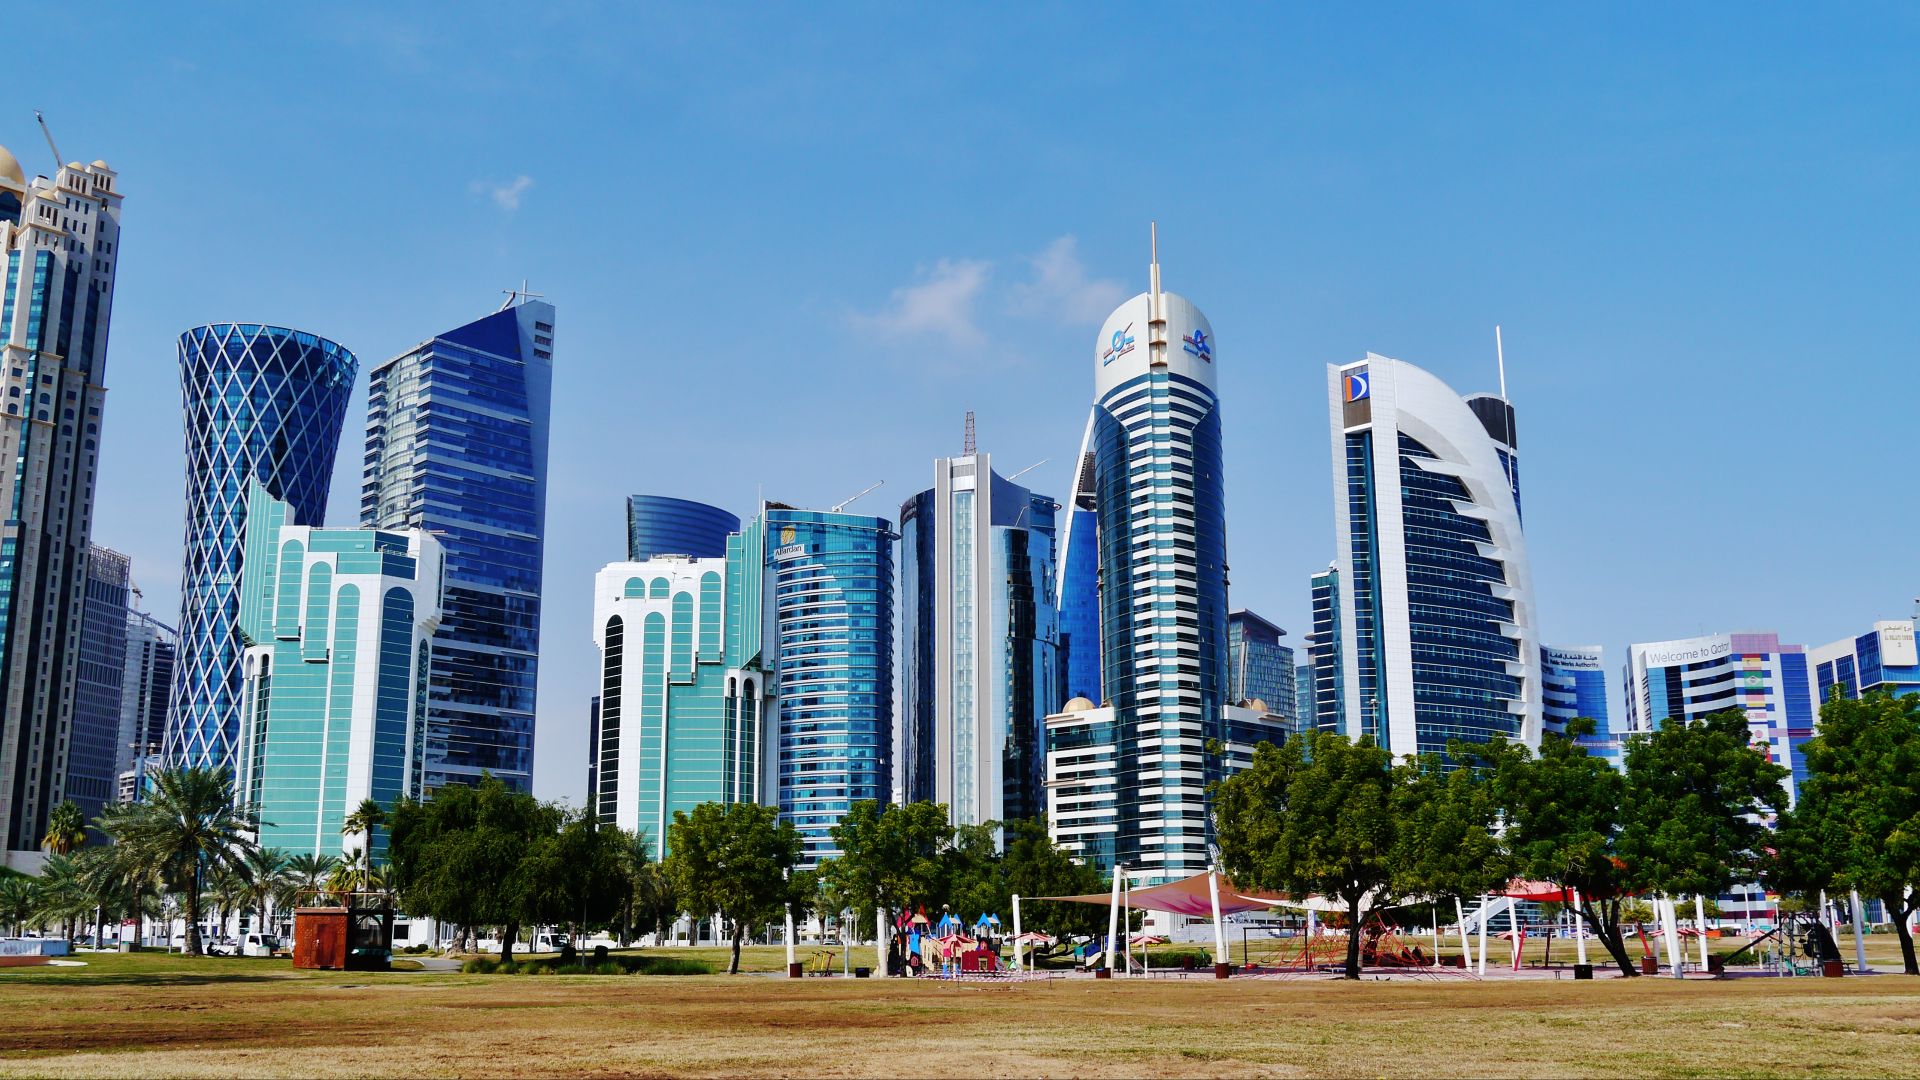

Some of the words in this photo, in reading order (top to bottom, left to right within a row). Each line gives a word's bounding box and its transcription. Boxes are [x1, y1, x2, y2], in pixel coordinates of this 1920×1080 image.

[1650, 650, 1698, 664] Welcome
[1700, 648, 1710, 657] to
[1711, 641, 1730, 656] Qatar
